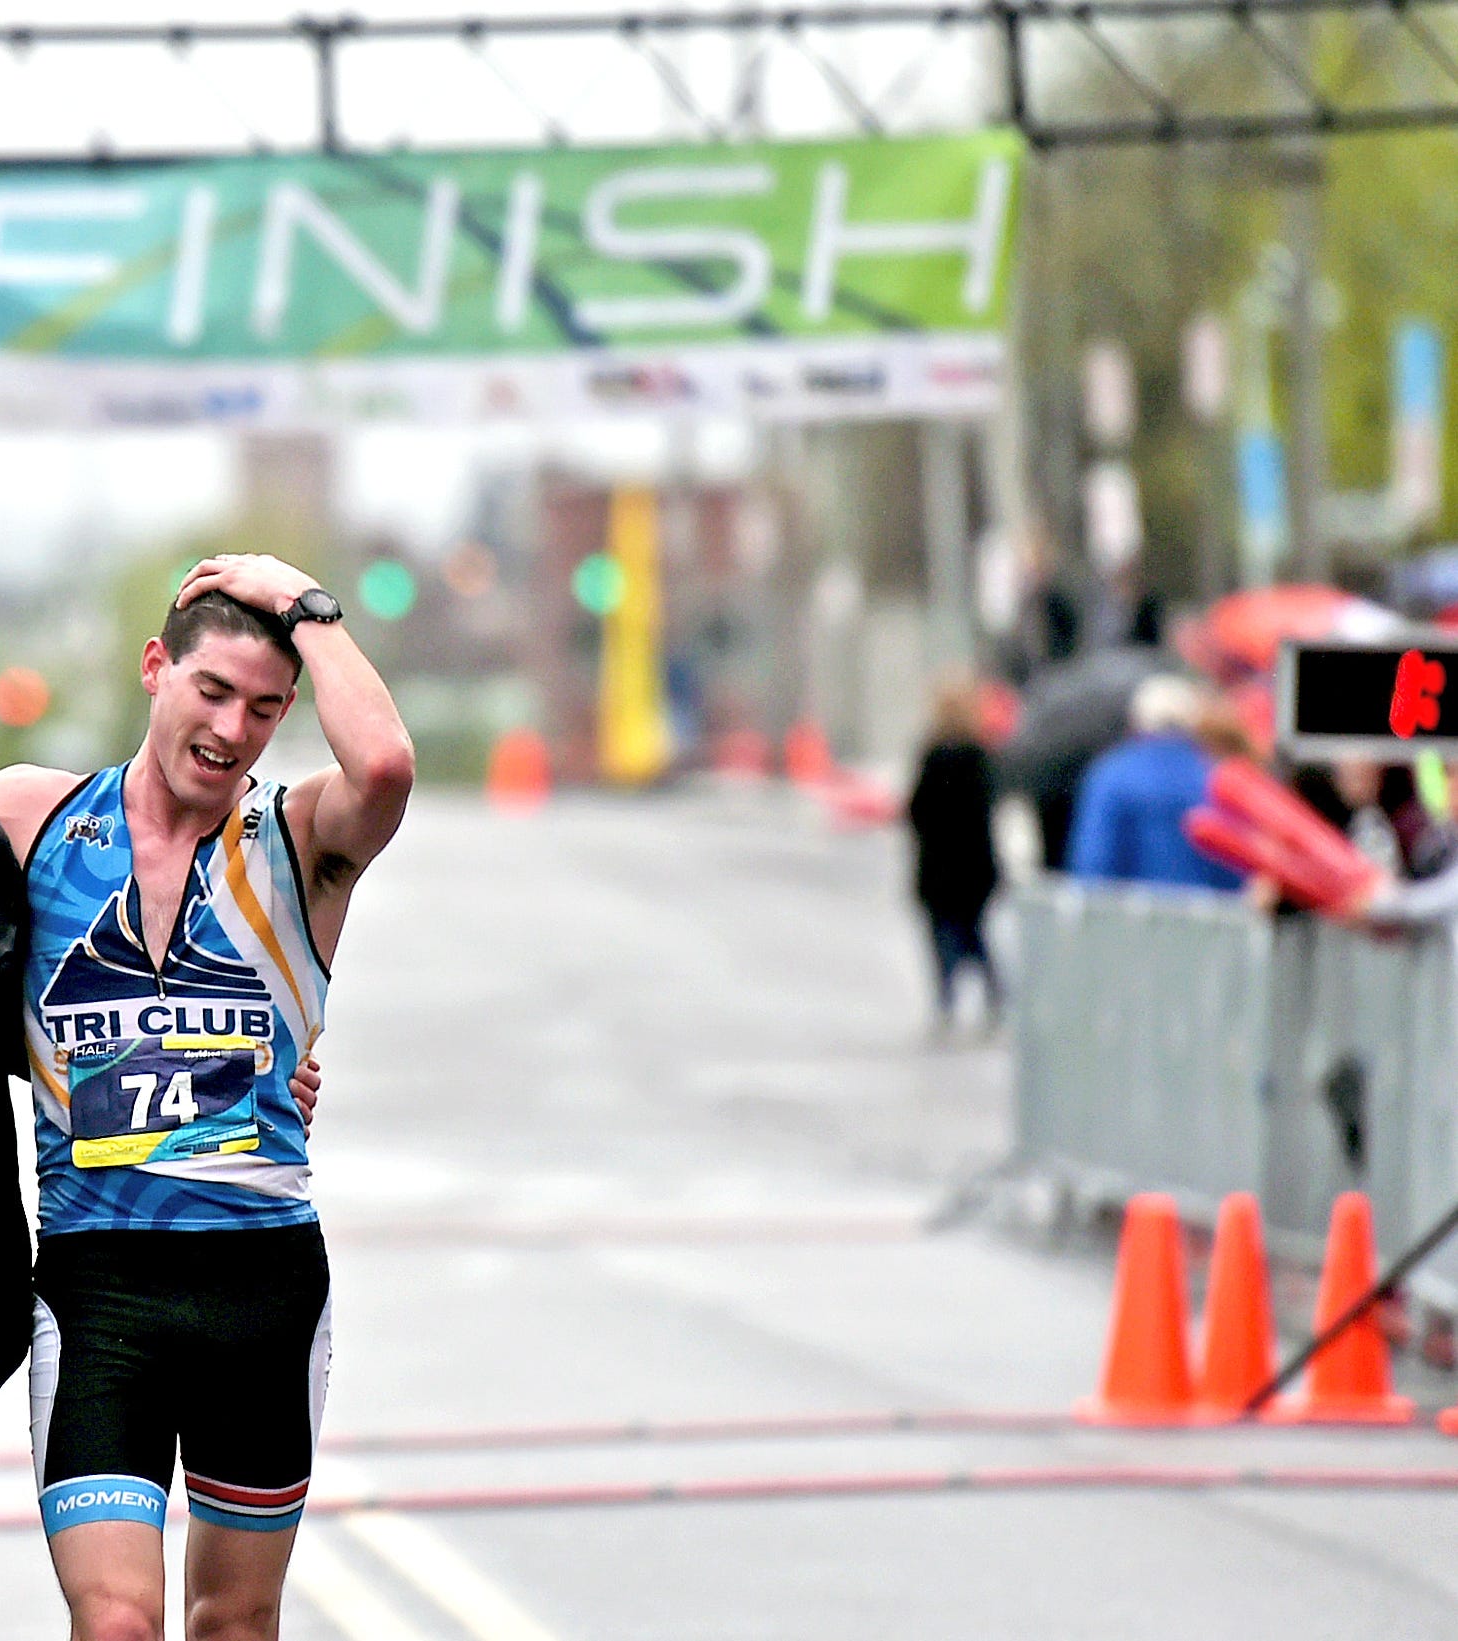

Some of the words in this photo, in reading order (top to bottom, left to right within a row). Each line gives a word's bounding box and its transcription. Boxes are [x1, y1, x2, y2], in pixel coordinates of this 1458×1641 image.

[46, 1010, 121, 1043] TRI
[137, 1005, 271, 1037] CLUB
[74, 1043, 118, 1057] HALF
[120, 1070, 199, 1129] 74
[57, 1491, 160, 1514] MOMENT
